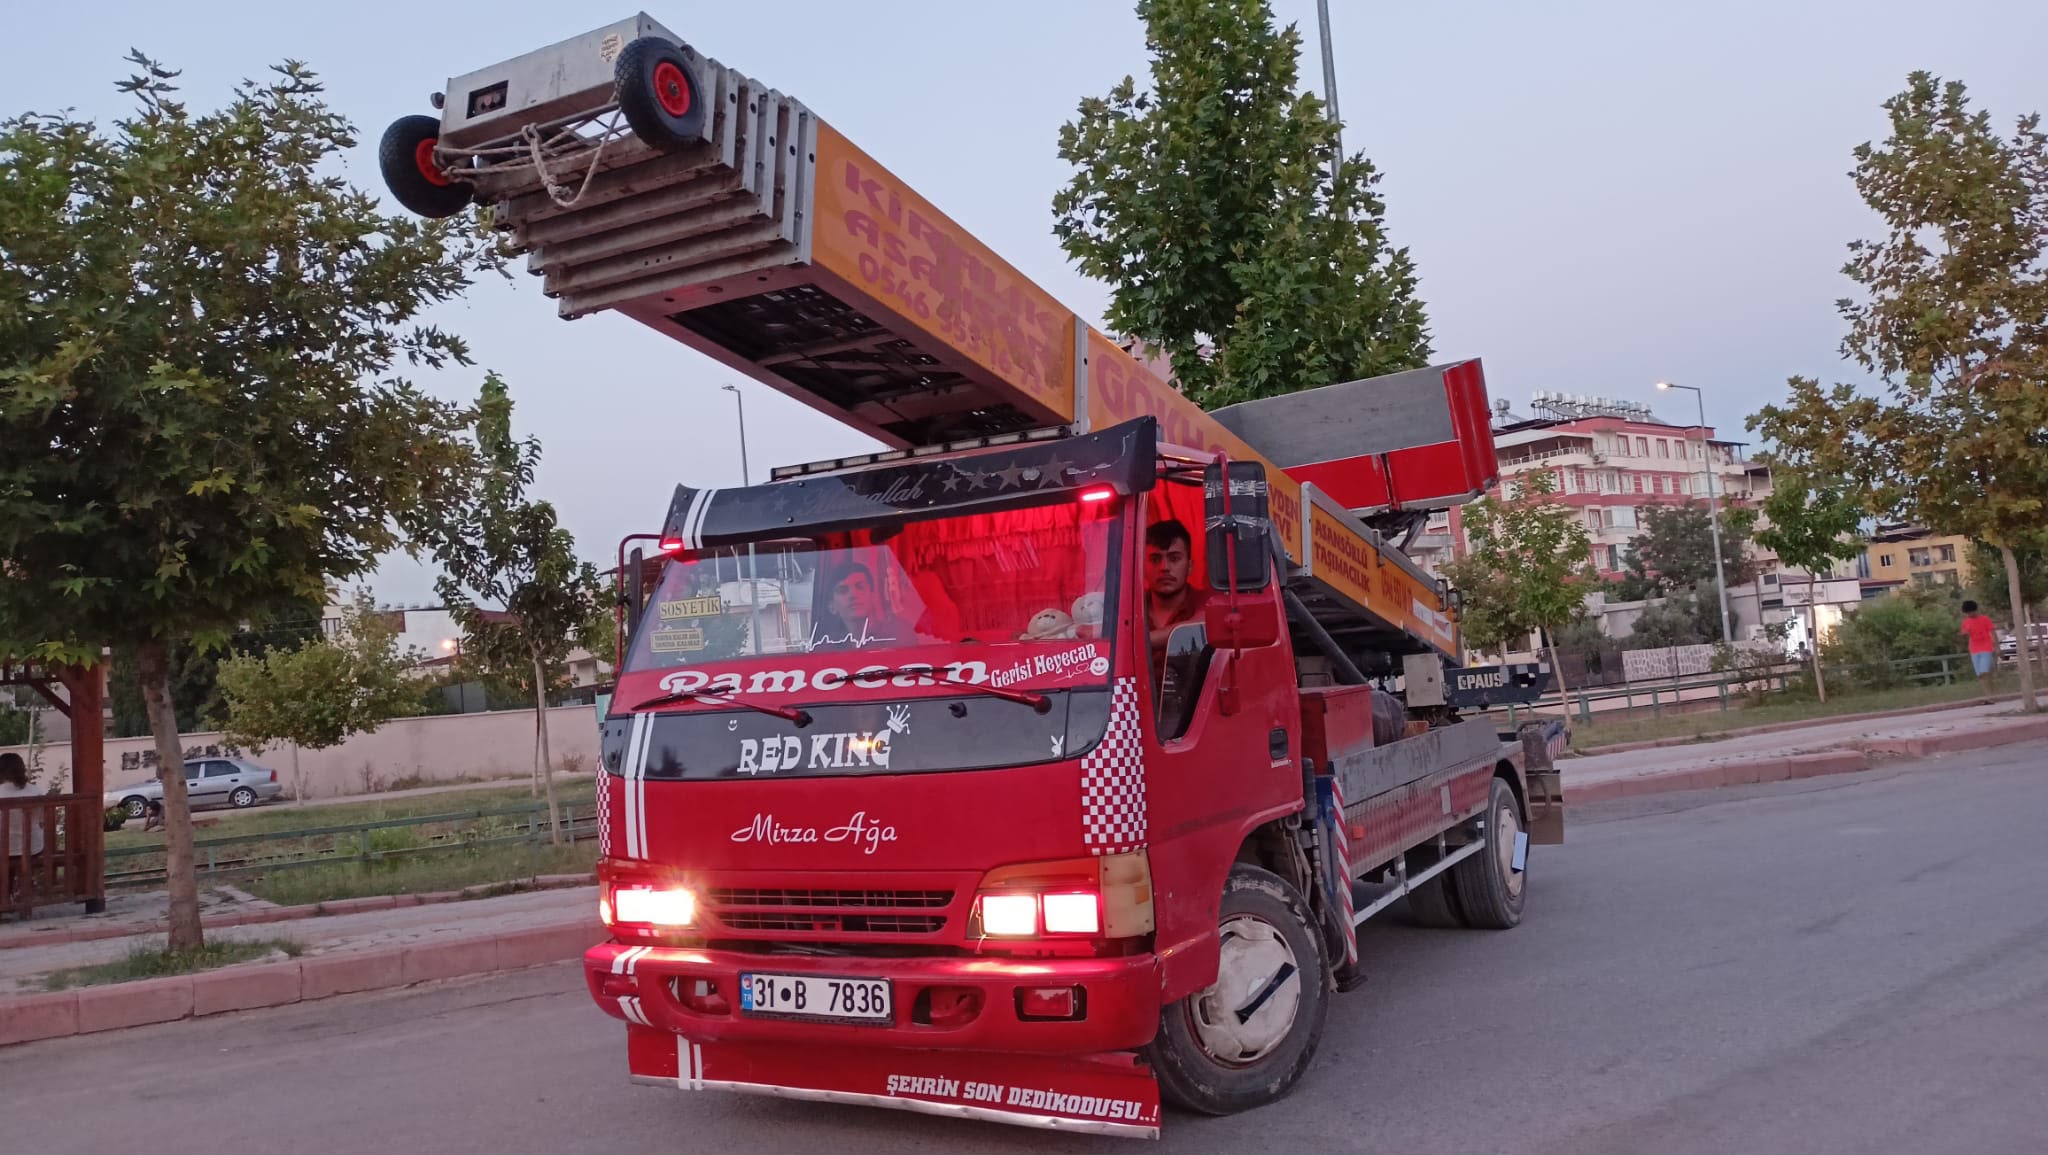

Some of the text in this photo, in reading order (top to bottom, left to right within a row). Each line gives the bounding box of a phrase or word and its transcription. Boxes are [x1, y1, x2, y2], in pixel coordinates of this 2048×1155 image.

[858, 251, 930, 320] 0546
[1267, 482, 1299, 523] VDEN
[1315, 519, 1368, 569] ASANSÖRLÜ
[1314, 542, 1370, 593] TAŞIMACILIK
[659, 660, 991, 704] Ramocan
[991, 643, 1097, 688] Gerisi Heyecan
[737, 728, 892, 776] RED KING
[730, 811, 898, 855] Mirza Ağa
[755, 978, 775, 1008] 31
[795, 980, 807, 1010] B
[828, 982, 885, 1014] 7836
[887, 1075, 1159, 1122] ŞEHRİN SON DEDİKODUSU..!
